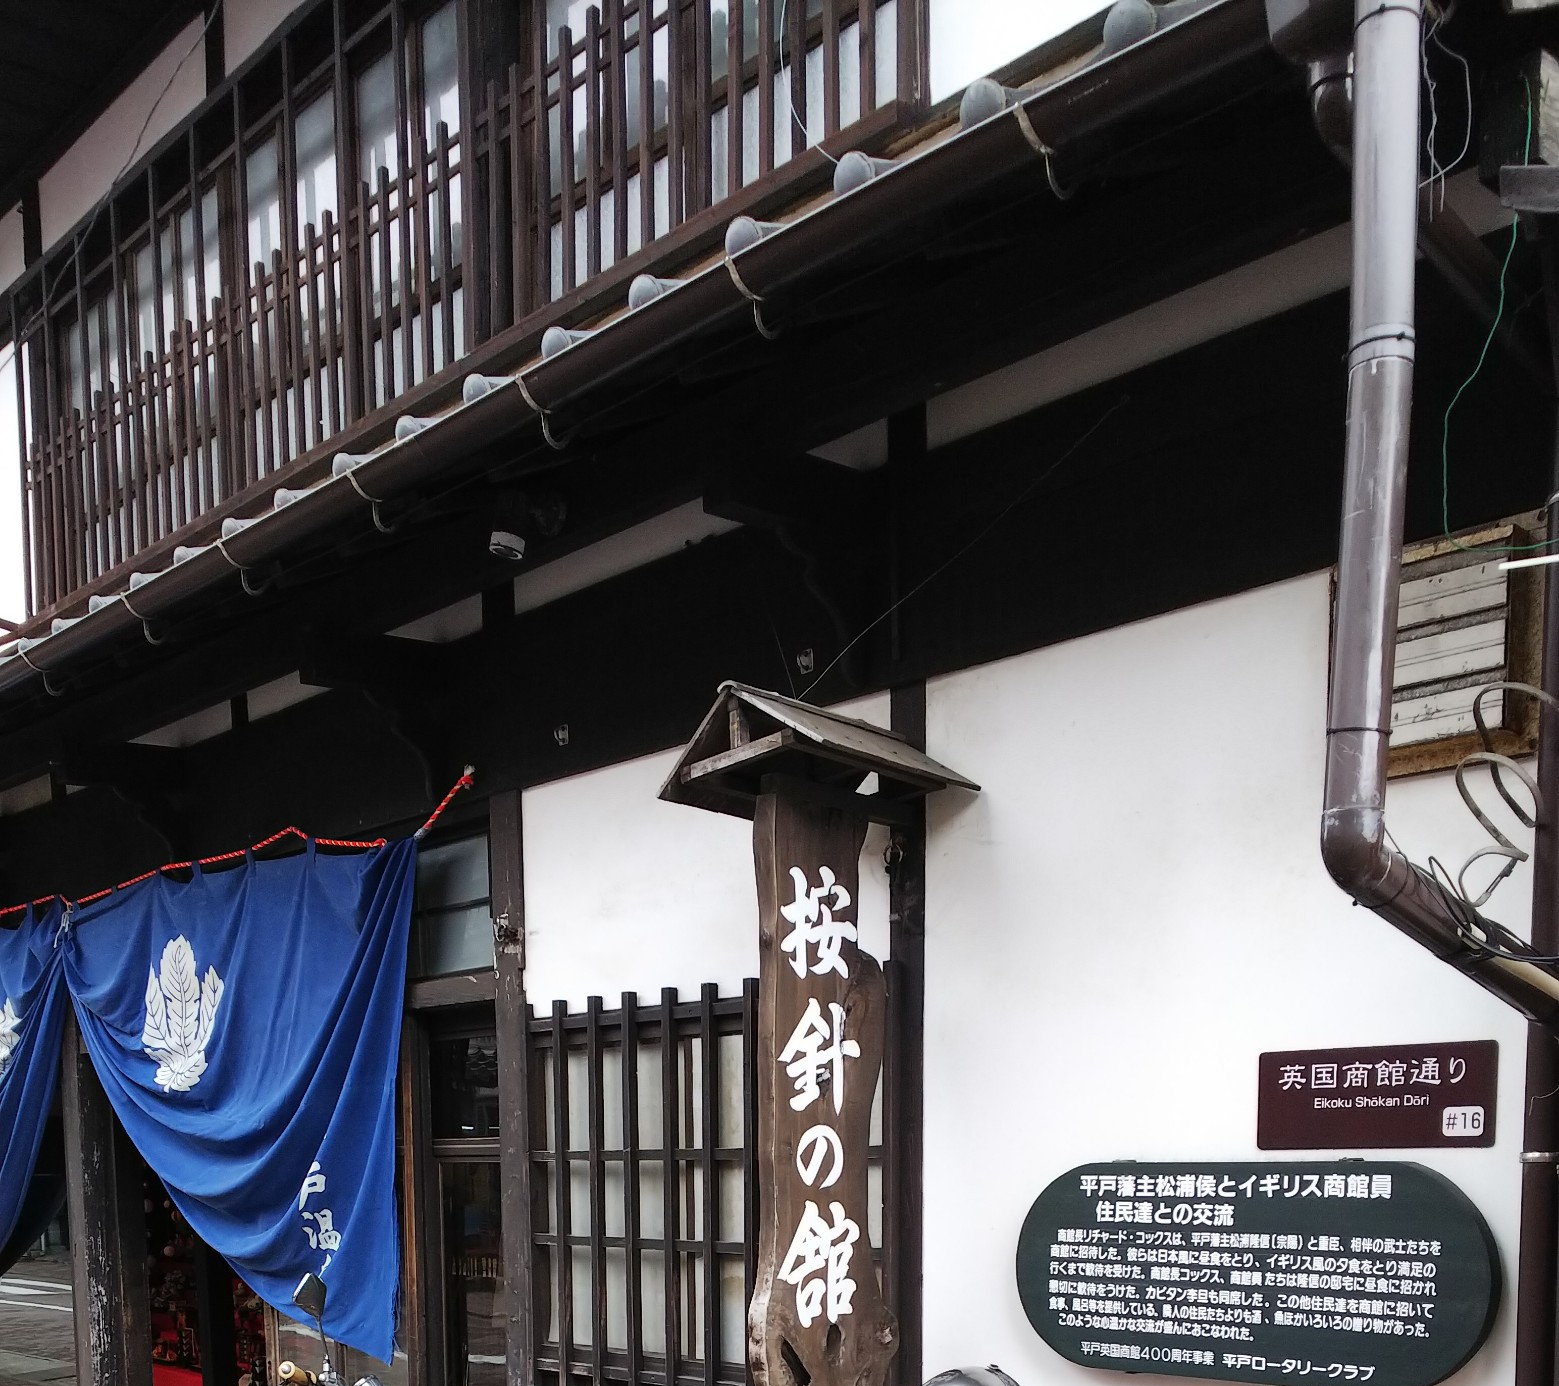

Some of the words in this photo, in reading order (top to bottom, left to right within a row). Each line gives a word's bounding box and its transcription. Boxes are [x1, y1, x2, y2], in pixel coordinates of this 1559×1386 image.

[1278, 1056, 1466, 1091] 英国商館通り
[1313, 1097, 1352, 1109] Eikoku
[1355, 1095, 1400, 1108] Shōkan
[1403, 1094, 1430, 1106] Dōri
[1446, 1111, 1482, 1130] #16
[1079, 1174, 1392, 1199] 平戸藩主松浦侯とイギリス商館員
[1095, 1201, 1235, 1227] 住民達との交流
[1221, 1353, 1376, 1382] 平戸ロータリークラブ
